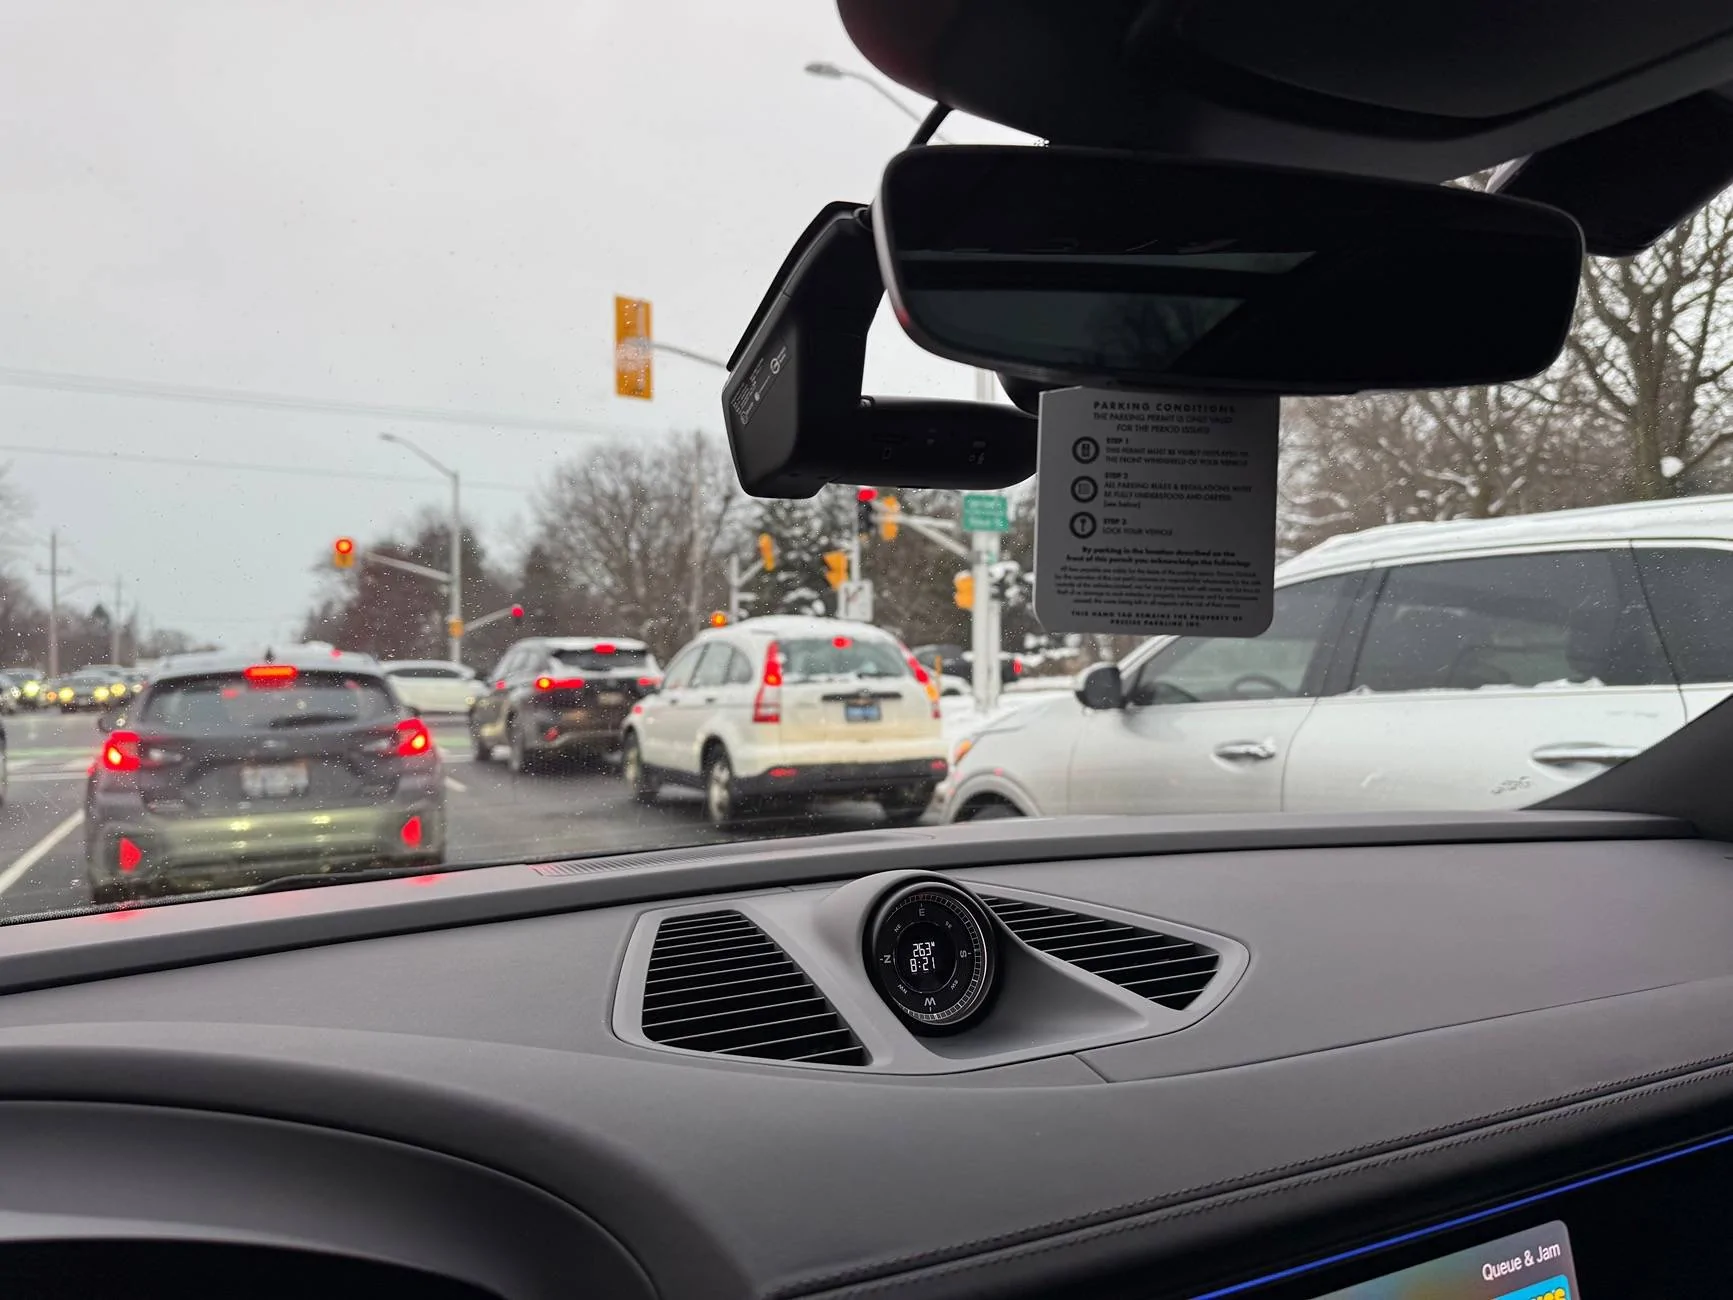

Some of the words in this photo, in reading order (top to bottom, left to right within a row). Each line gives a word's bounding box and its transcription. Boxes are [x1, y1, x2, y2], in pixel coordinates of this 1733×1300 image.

[1093, 402, 1150, 412] PARKING
[1156, 403, 1236, 413] CONDITIONS
[1093, 412, 1108, 420] THE
[1109, 413, 1146, 421] PARKING
[1147, 414, 1175, 422] PERMIT
[1117, 424, 1132, 432] FOR
[1151, 425, 1180, 433] PERIOD
[919, 908, 926, 917] E
[883, 954, 892, 964] N
[960, 950, 967, 958] S
[909, 956, 936, 973] 8:21
[924, 997, 936, 1007] W
[1482, 1256, 1523, 1281] Queue
[1524, 1249, 1535, 1267] &
[1536, 1243, 1561, 1263] Jam
